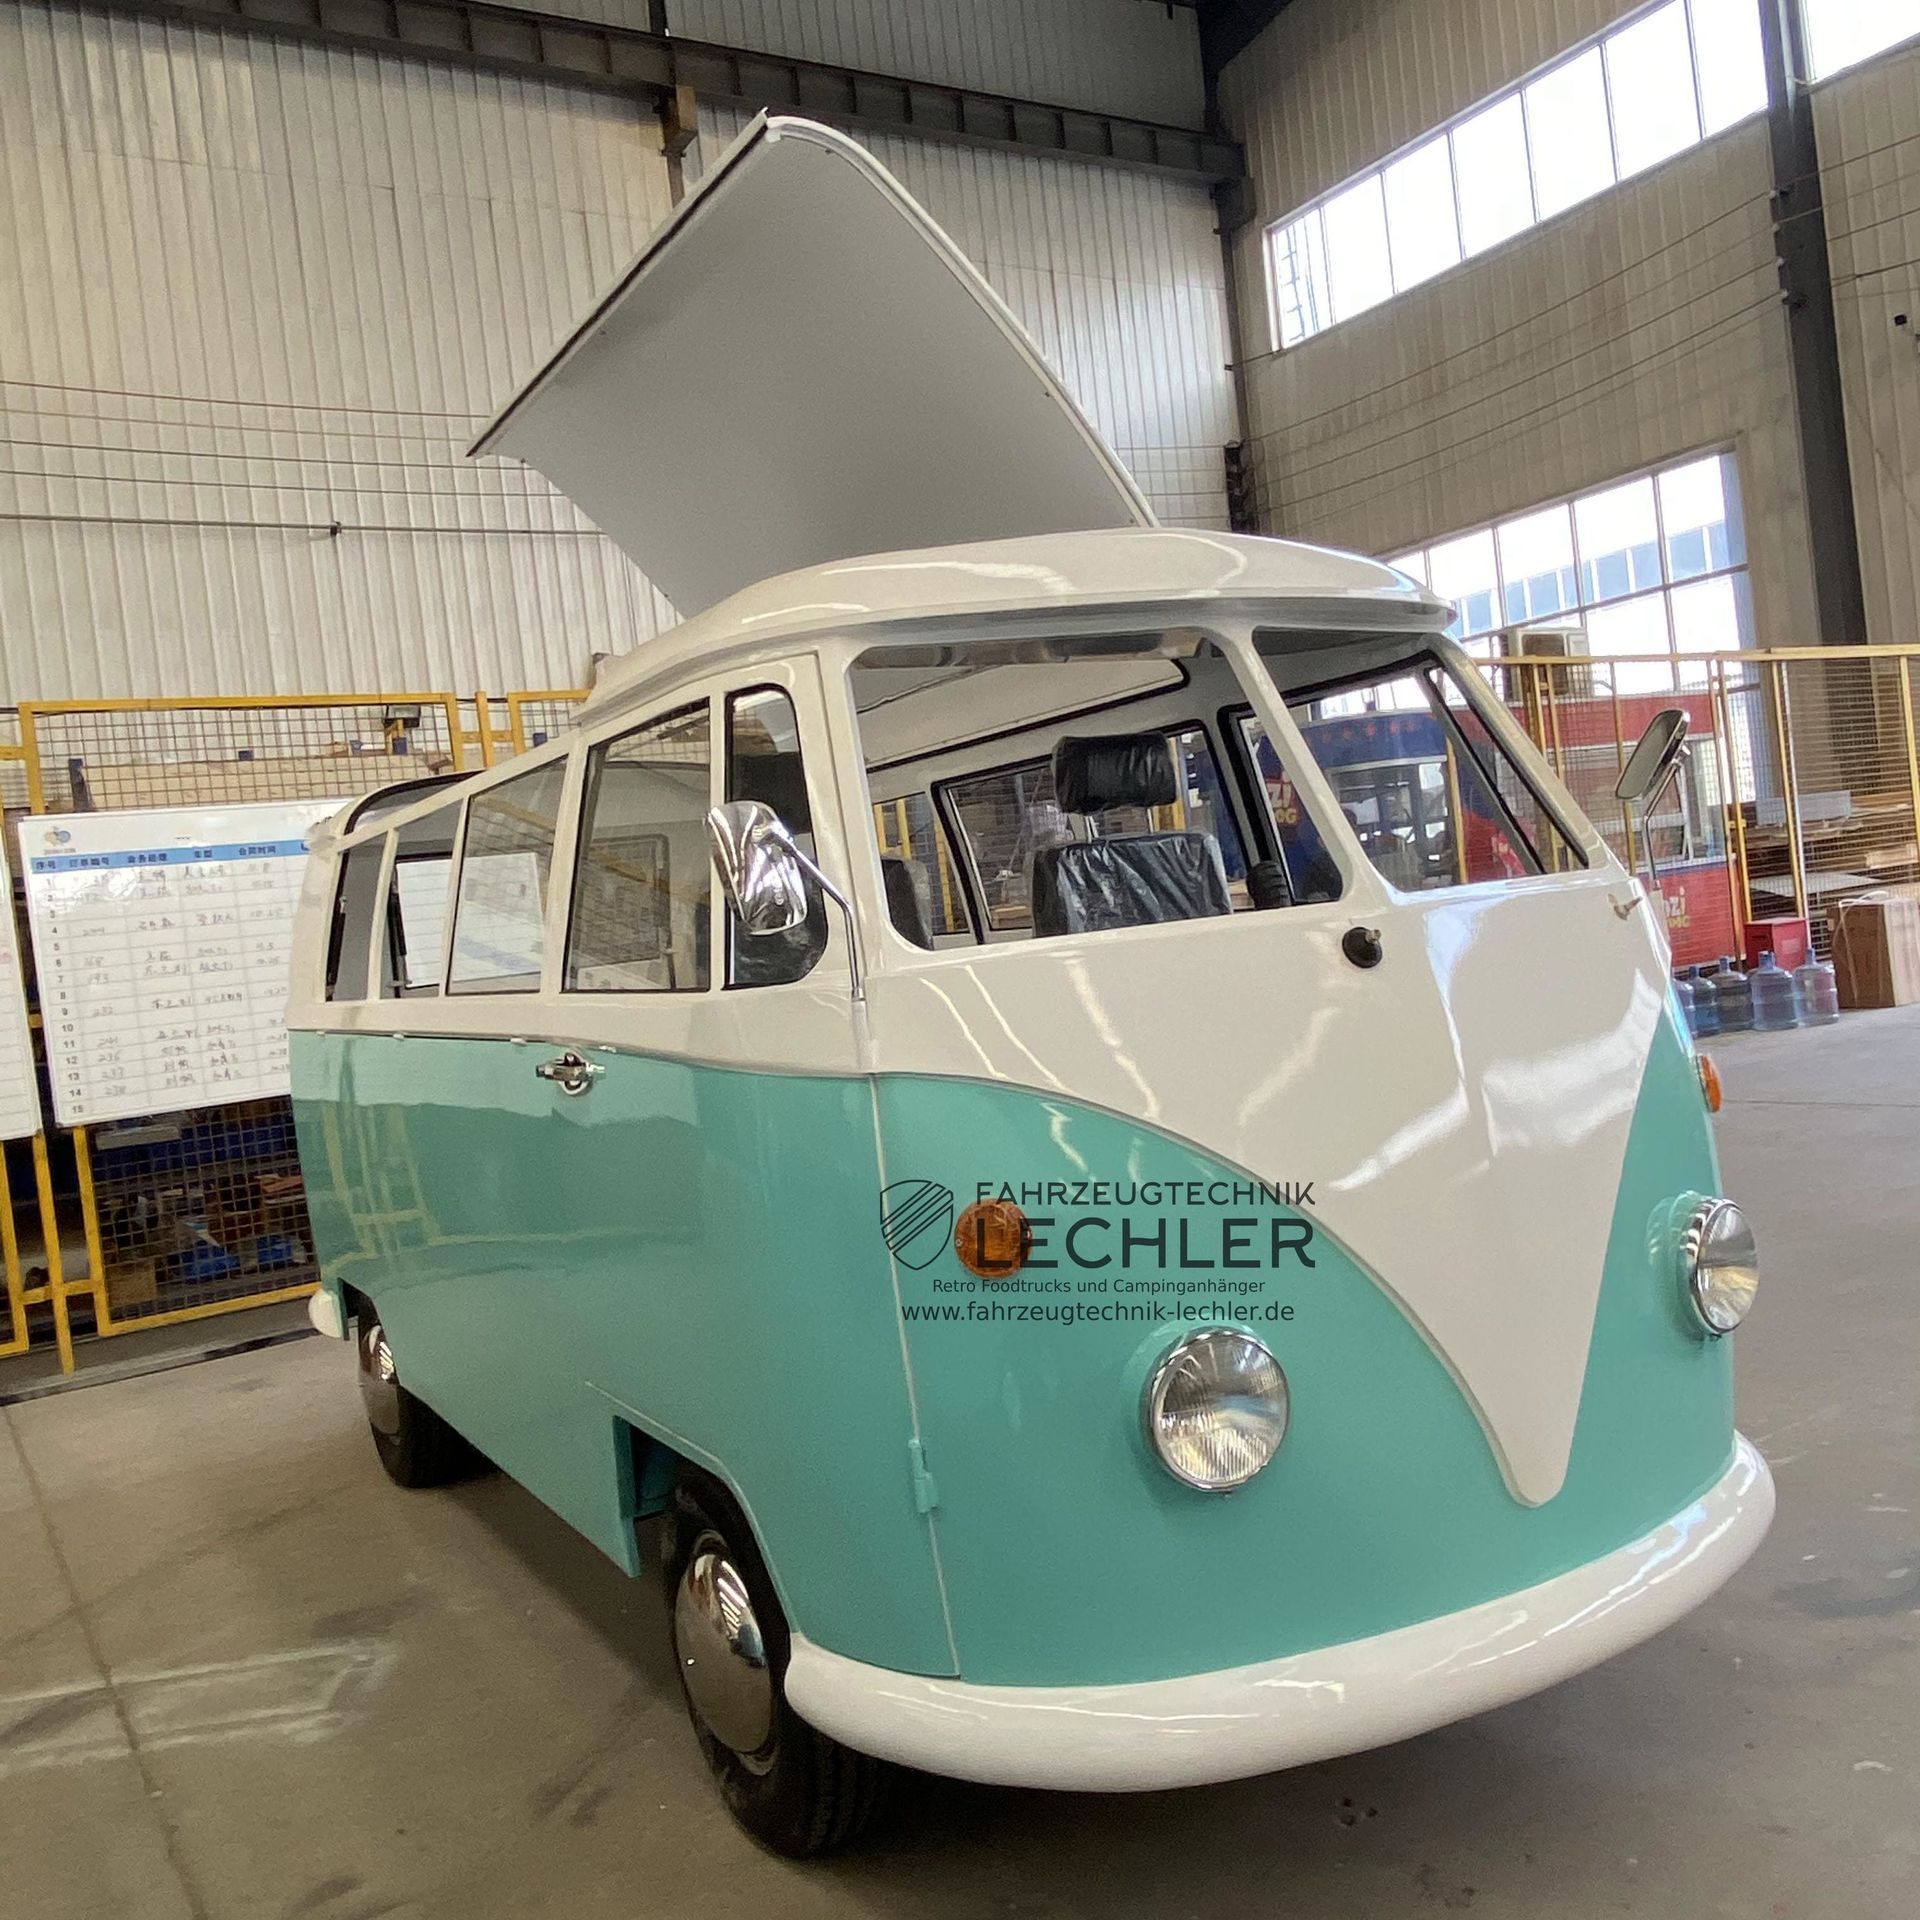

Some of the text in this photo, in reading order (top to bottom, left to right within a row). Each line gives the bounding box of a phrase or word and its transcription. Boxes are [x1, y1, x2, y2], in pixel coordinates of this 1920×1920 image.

[52, 926, 58, 934] 4
[53, 942, 60, 951] 5
[62, 1023, 74, 1032] 10
[63, 1040, 75, 1048] 11
[66, 1056, 78, 1065] 12
[68, 1072, 80, 1081] 13
[69, 1089, 82, 1097] 14
[72, 1105, 84, 1113] 15
